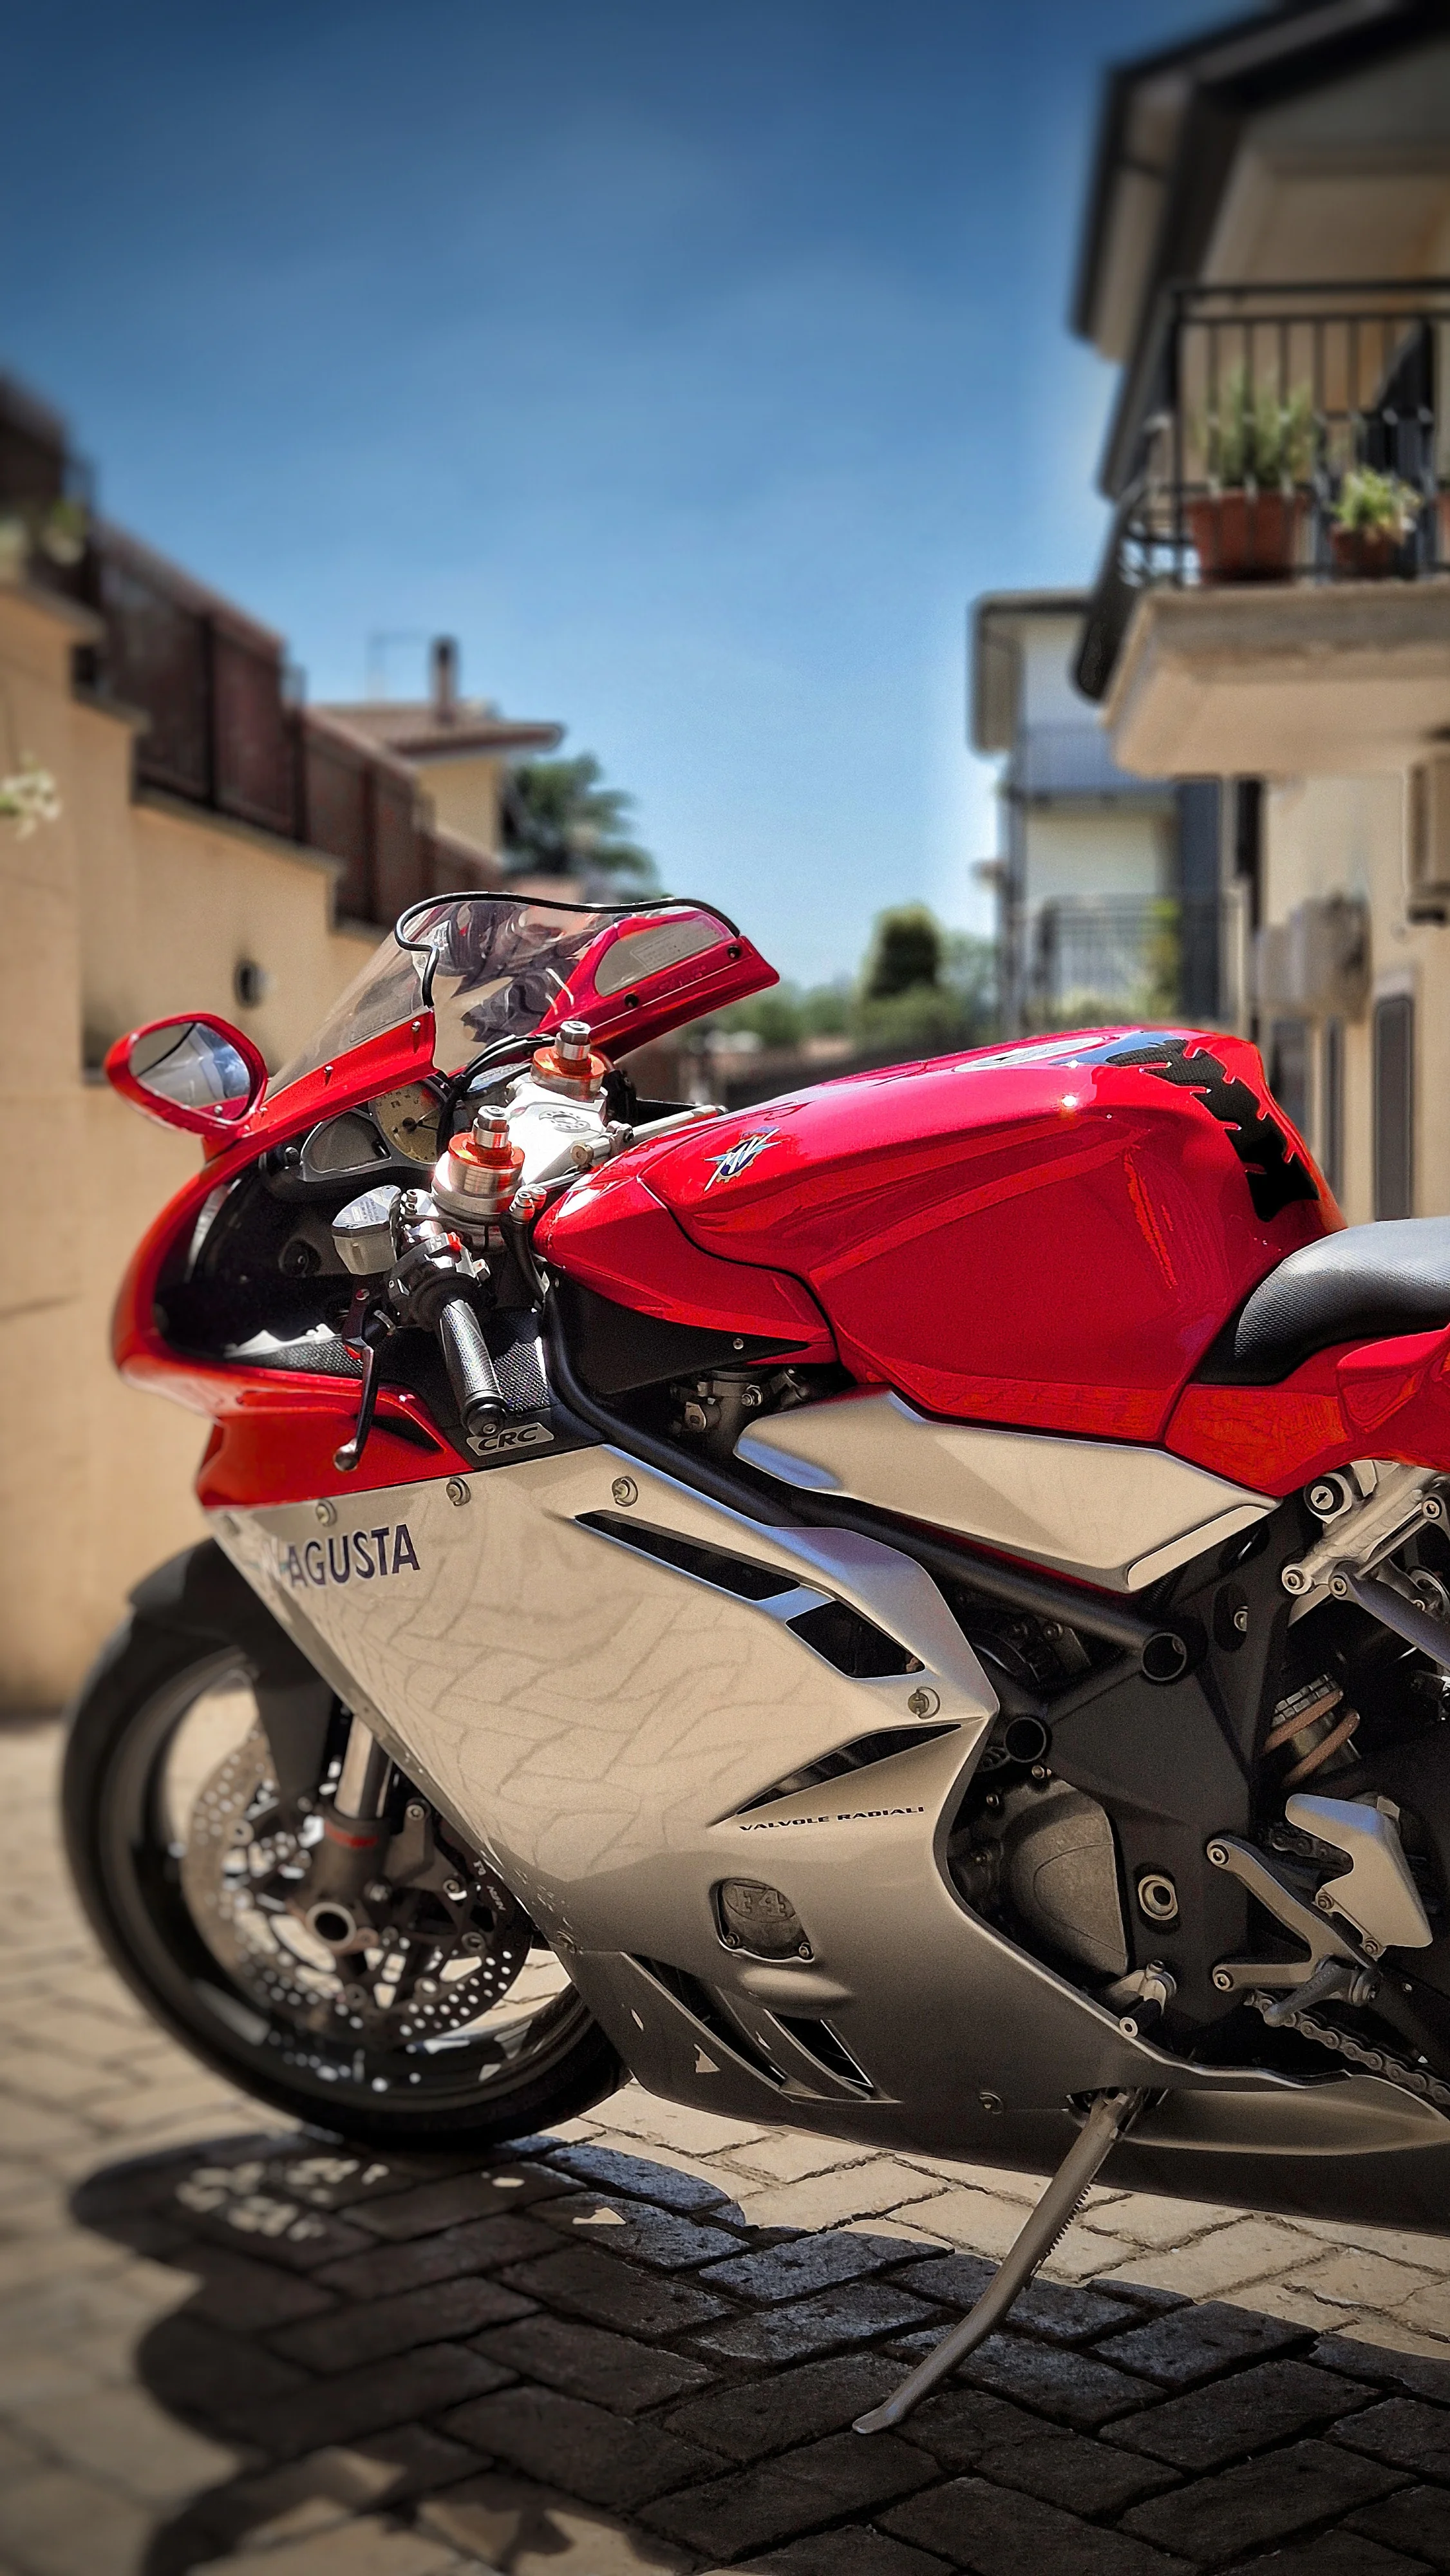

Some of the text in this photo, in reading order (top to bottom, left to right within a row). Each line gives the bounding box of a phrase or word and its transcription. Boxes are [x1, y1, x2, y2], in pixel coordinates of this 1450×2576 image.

[478, 1426, 538, 1450] CRC
[287, 1523, 420, 1587] AGUSTA
[739, 1806, 925, 1831] VALVOLE RADIALI
